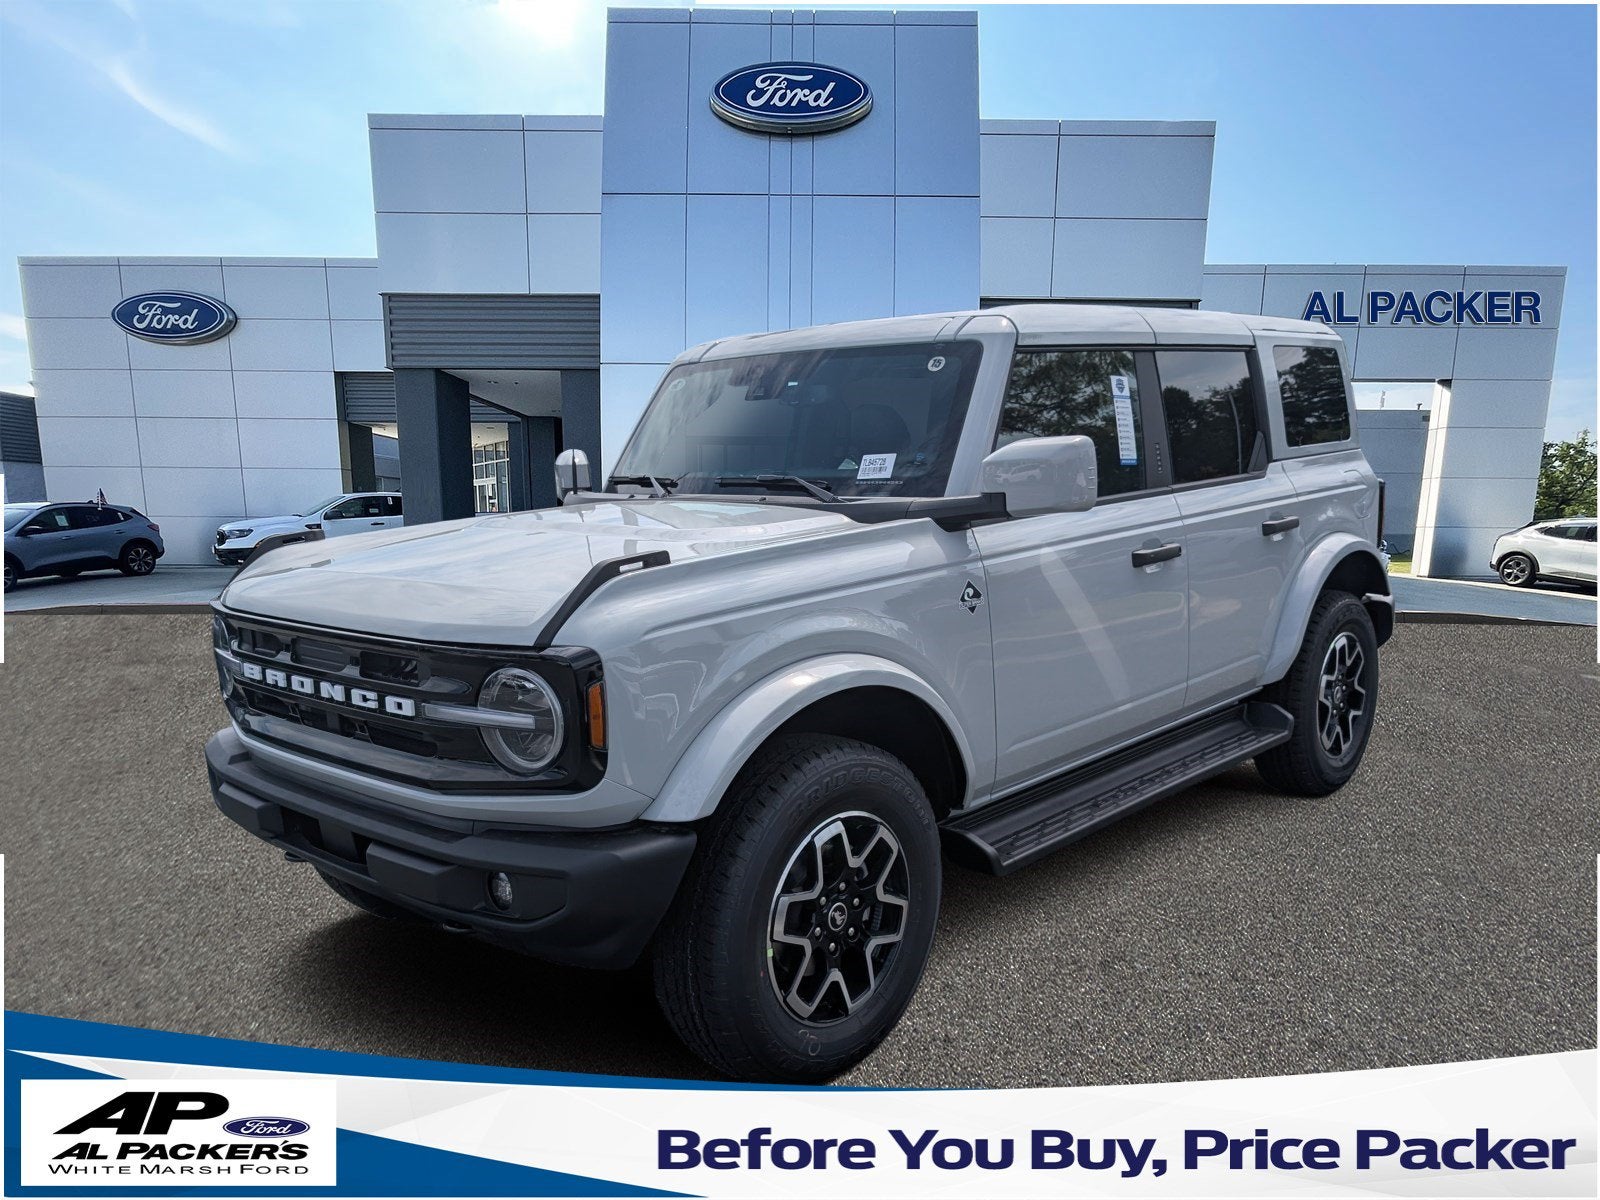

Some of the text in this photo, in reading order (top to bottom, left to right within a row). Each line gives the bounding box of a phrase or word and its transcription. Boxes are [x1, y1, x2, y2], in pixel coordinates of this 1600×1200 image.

[746, 73, 836, 107] Ford
[133, 301, 198, 329] Ford
[1303, 290, 1542, 324] AL PACKER
[243, 662, 416, 717] BRONCO
